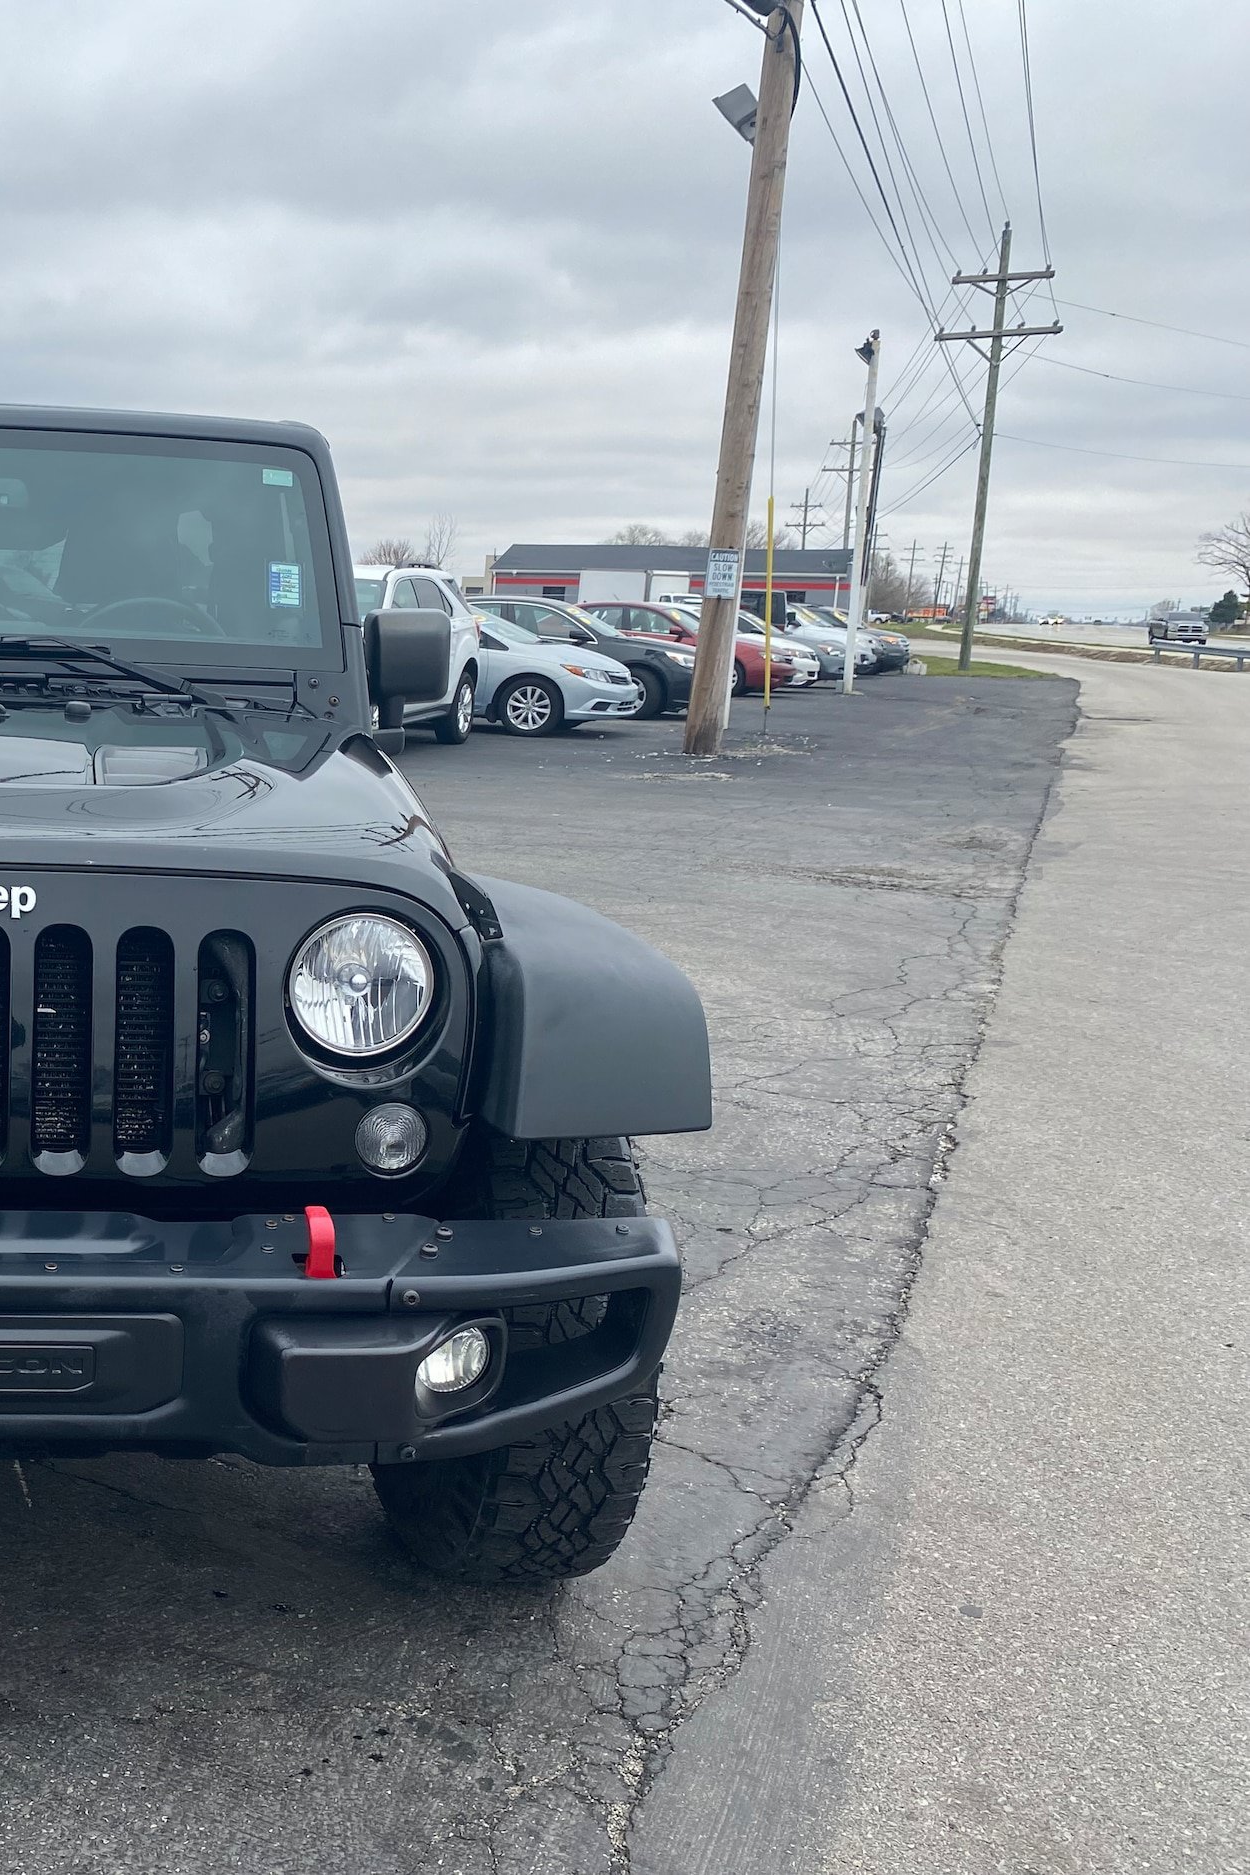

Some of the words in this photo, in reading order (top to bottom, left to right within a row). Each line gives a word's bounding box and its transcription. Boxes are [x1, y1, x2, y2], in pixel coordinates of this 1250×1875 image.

[711, 552, 738, 562] CAUTION
[713, 563, 733, 571] SLOW
[712, 573, 733, 581] DOWN
